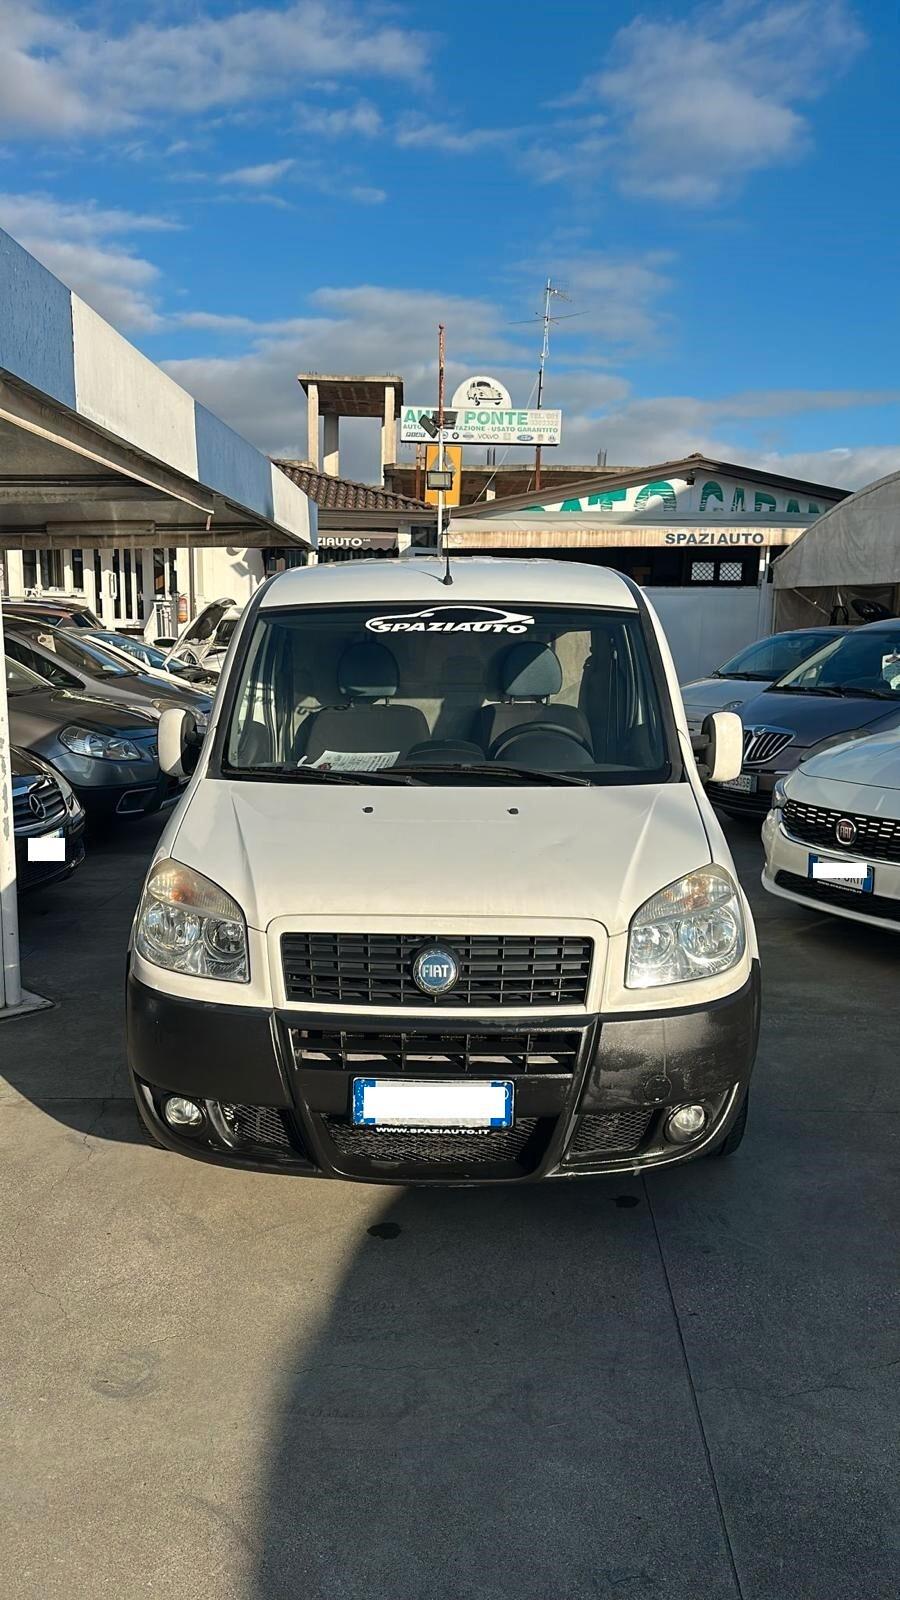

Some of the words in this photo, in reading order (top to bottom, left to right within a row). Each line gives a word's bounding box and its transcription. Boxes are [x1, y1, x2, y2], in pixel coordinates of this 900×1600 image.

[464, 411, 528, 425] PONTE
[318, 537, 363, 547] ZIAUTO
[665, 533, 764, 545] SPAZIAUTO
[377, 622, 528, 634] SPAZIAUTO
[840, 825, 852, 839] FIAT
[422, 964, 449, 978] FIAT
[376, 1127, 490, 1135] WWW.SPAZIAUTO.IT
